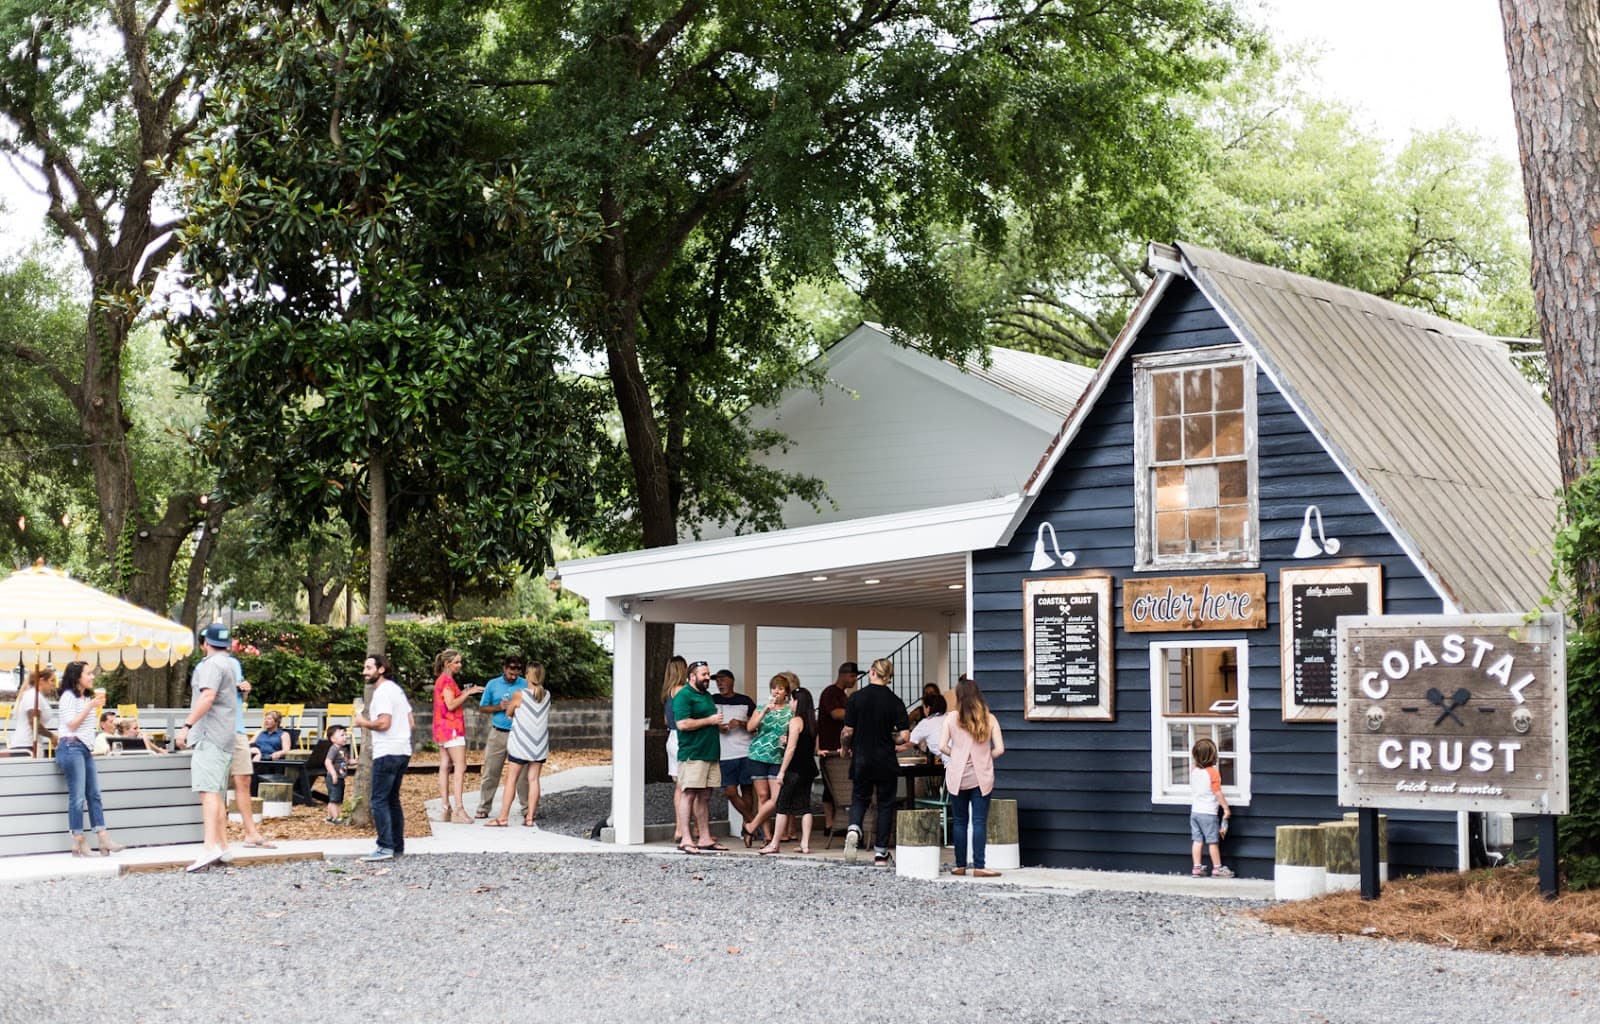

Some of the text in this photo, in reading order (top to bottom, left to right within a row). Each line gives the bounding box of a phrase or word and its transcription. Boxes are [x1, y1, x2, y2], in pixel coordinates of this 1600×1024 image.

[1038, 596, 1092, 605] COASTAL CRUST
[1132, 583, 1254, 622] order here
[1361, 634, 1536, 705] COASTAL
[1378, 740, 1521, 772] CRUST
[1396, 780, 1503, 795] brick and mortar
